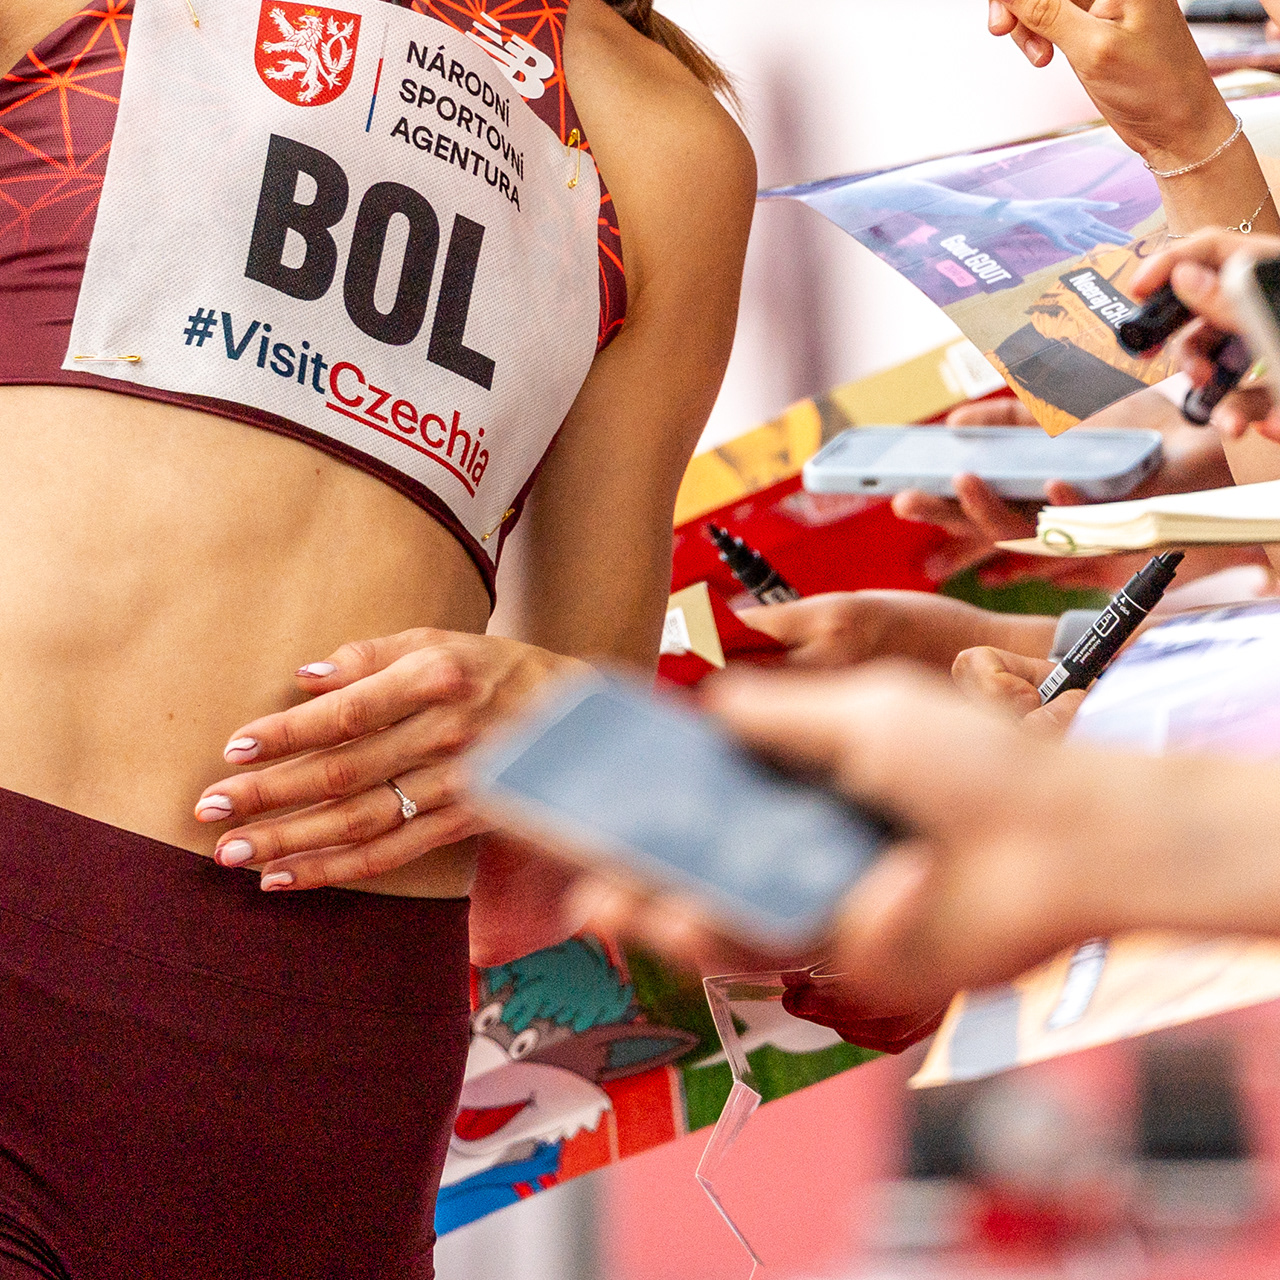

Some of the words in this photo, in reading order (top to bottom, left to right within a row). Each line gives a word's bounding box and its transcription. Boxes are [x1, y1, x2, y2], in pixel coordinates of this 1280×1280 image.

[399, 78, 524, 181] SPORTOVNÍ
[406, 40, 510, 127] NÁRODNÍ
[390, 116, 521, 213] AGENTURA
[244, 133, 495, 391] BOL
[939, 234, 979, 260] Gout
[964, 253, 1012, 285] GOUT
[1069, 271, 1118, 310] Neeraj
[183, 307, 490, 488] #VisitCzechia
